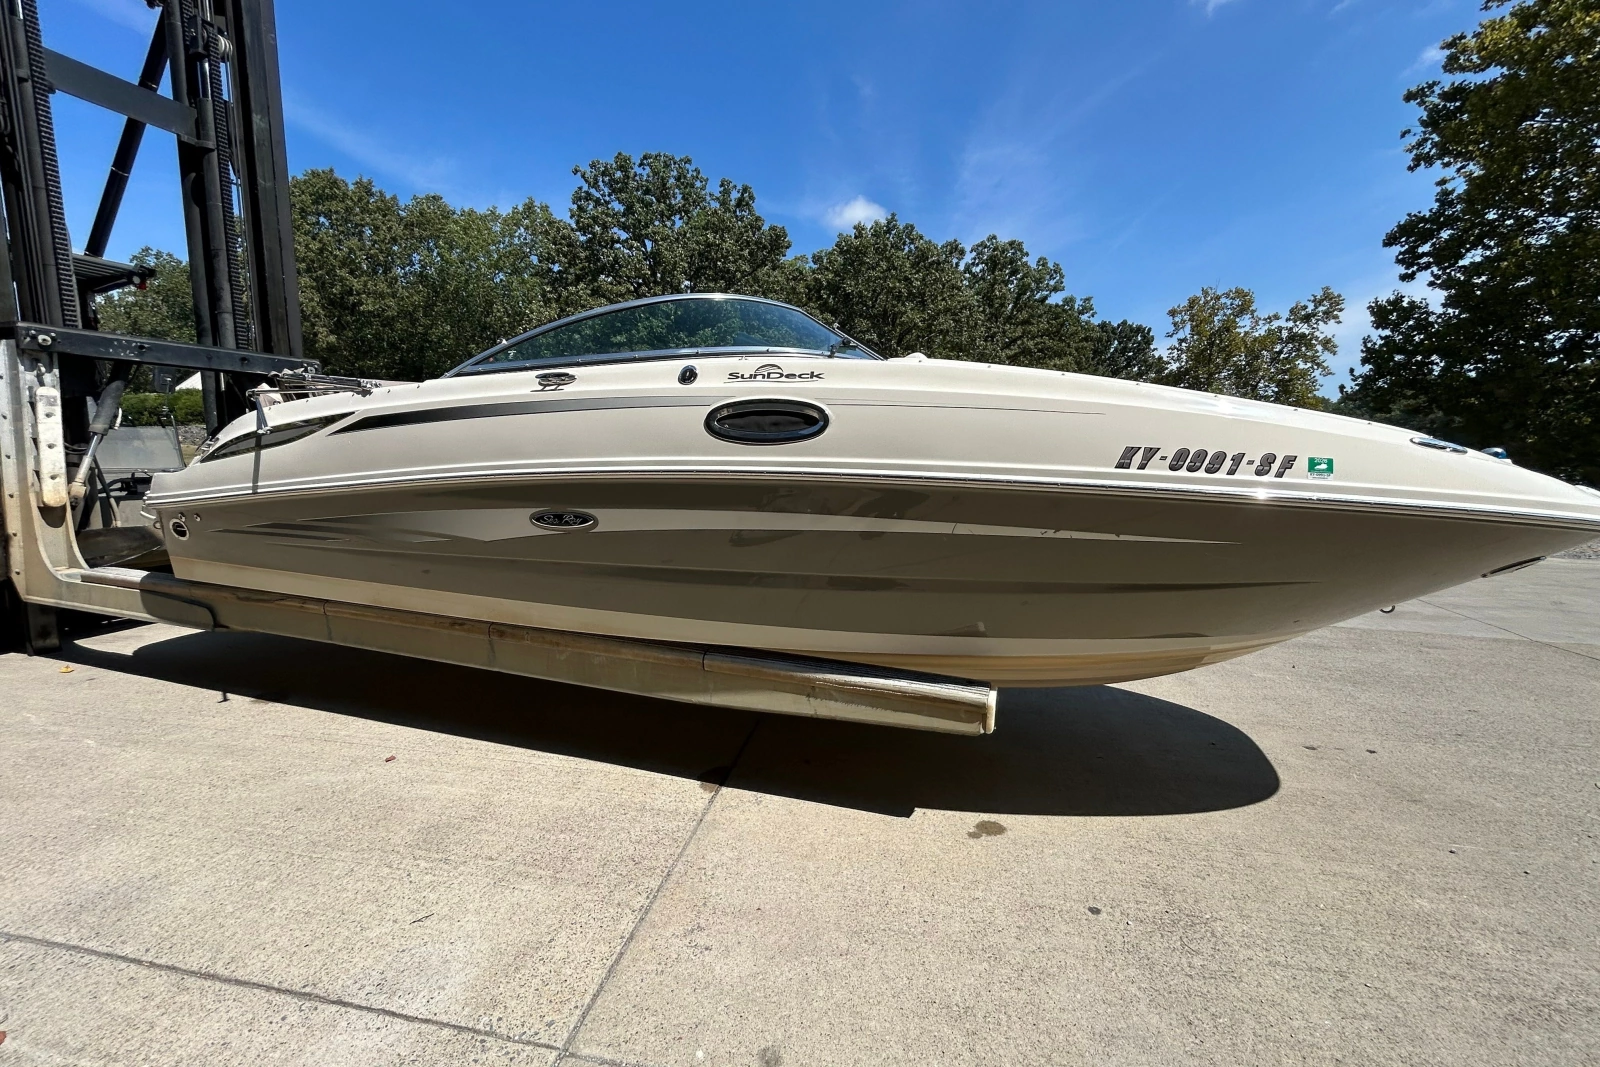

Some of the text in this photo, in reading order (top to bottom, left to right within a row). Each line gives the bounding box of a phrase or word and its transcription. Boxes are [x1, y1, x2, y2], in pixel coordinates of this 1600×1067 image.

[728, 371, 825, 380] SunDeck
[1114, 446, 1298, 479] KY-0991-SF
[540, 514, 583, 526] Sea Ray
